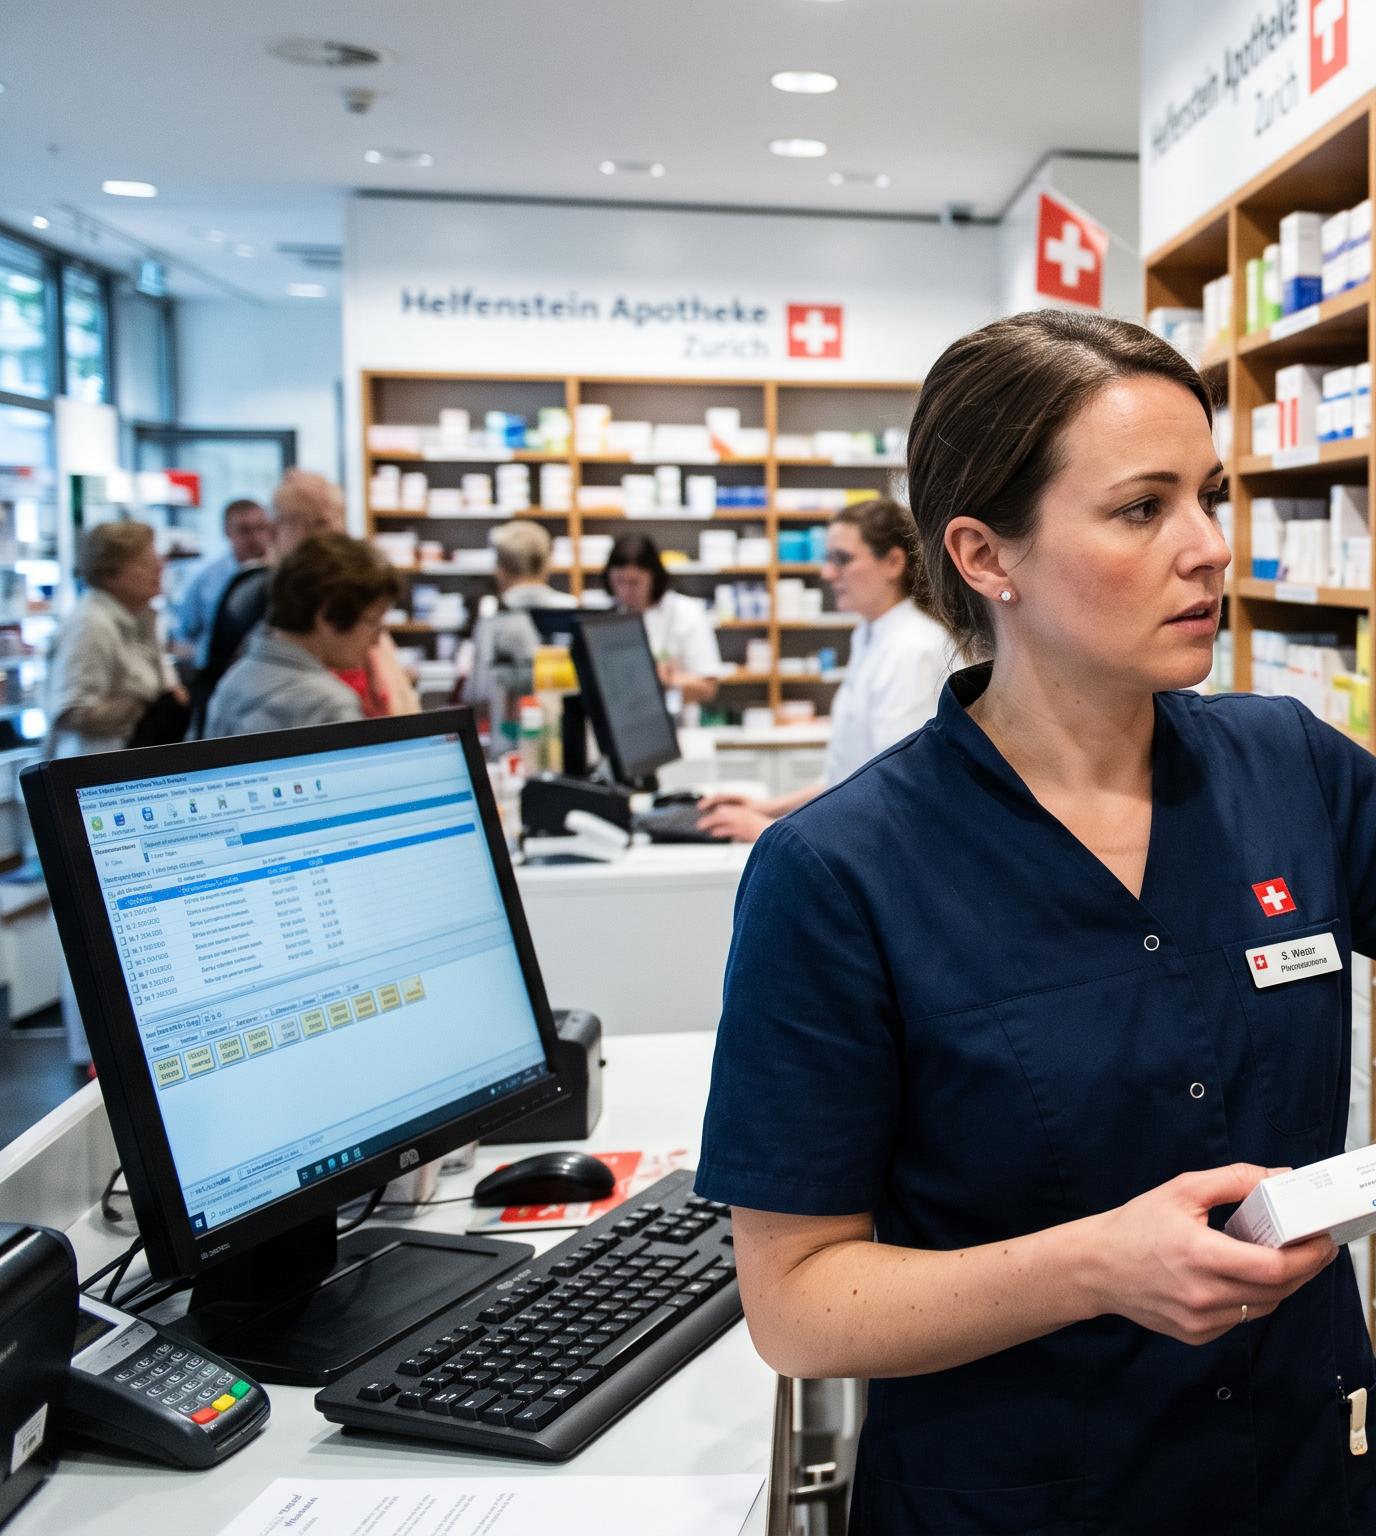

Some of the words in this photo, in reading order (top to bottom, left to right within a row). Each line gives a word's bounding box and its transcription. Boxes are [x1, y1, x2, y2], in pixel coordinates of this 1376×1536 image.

[401, 288, 599, 321] Helfenstein
[611, 296, 768, 328] Apotheke
[1281, 952, 1290, 960] S.
